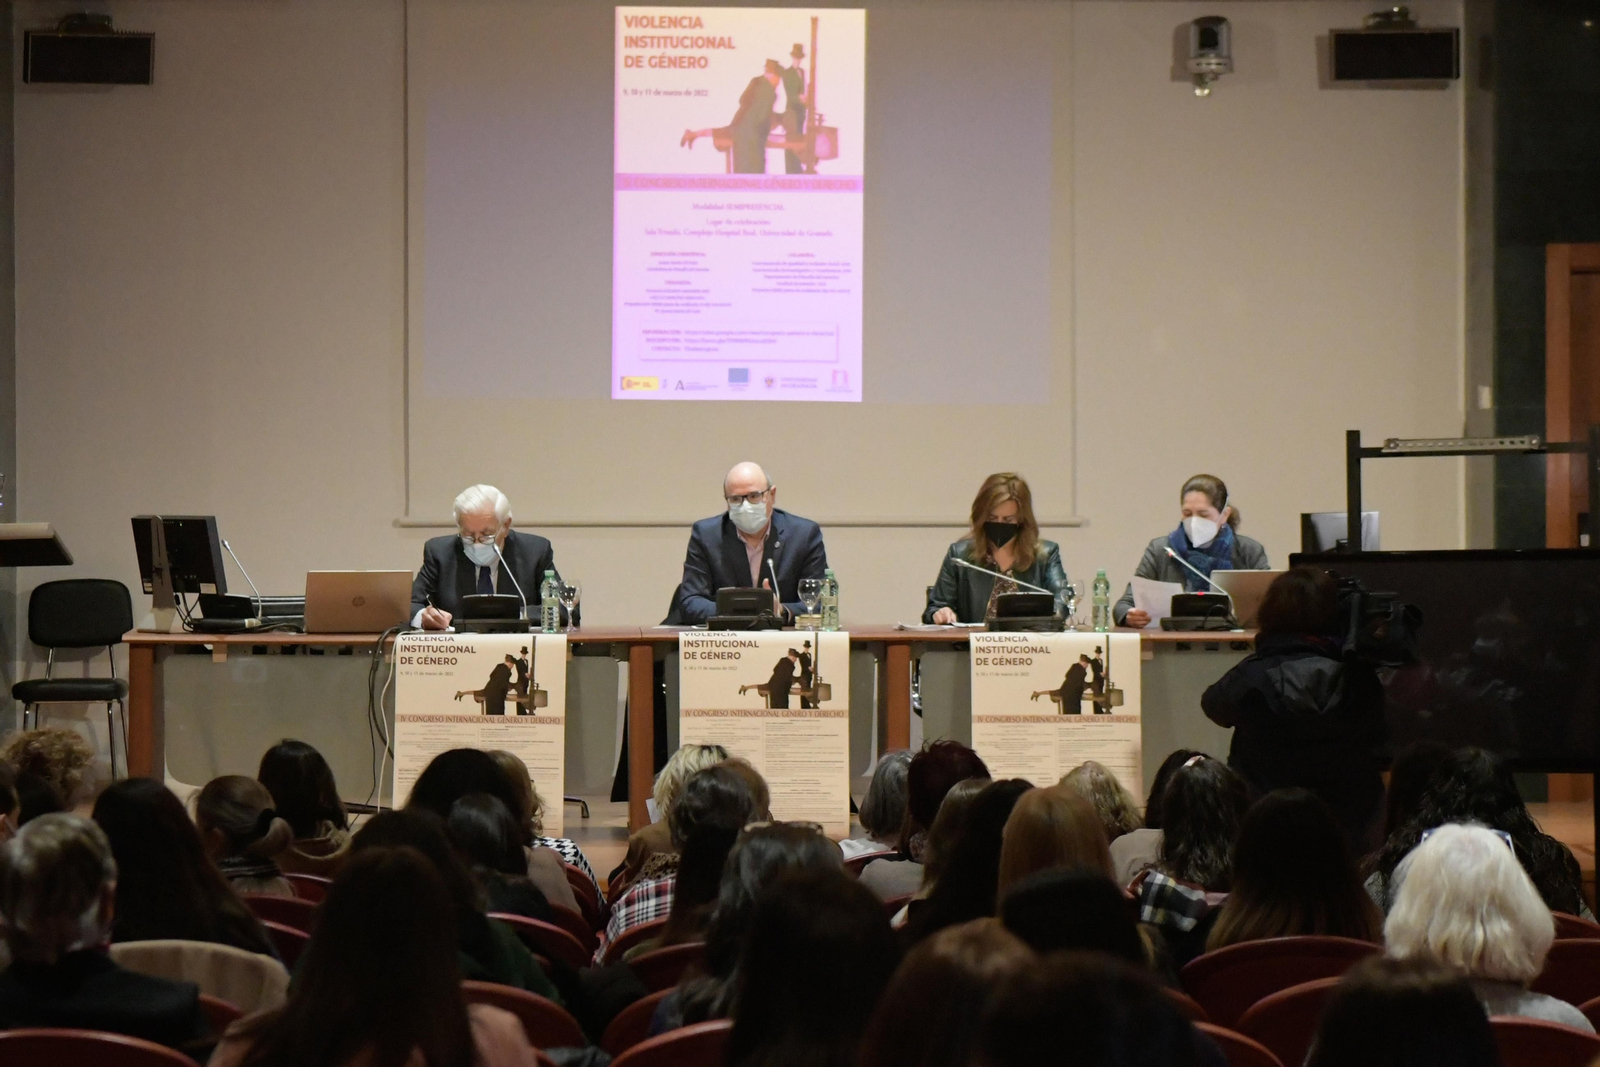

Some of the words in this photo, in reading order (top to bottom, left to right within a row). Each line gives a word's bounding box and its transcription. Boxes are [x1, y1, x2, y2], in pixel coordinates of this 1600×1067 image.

[624, 15, 704, 29] VIOLENCIA
[624, 35, 736, 50] INSTITUCIONAL
[623, 55, 644, 68] DE
[648, 52, 709, 69] GÉNERO
[653, 88, 661, 97] de
[662, 88, 683, 97] marzo
[684, 88, 692, 97] de
[693, 88, 709, 97] 2022
[683, 640, 759, 648] INSTITUCIONAL
[400, 645, 476, 654] INSTITUCIONAL
[975, 646, 1051, 654] INSTITUCIONAL
[684, 652, 697, 660] DE
[700, 650, 741, 660] GÉNERO
[400, 656, 414, 665] DE
[416, 655, 458, 666] GÉNERO
[975, 657, 989, 666] DE
[992, 656, 1033, 666] GÉNERO
[730, 710, 779, 718] INTERNACIONAL
[814, 710, 844, 718] DERECHO
[985, 715, 1021, 723] CONGRESO
[1022, 715, 1072, 723] INTERNACIONAL
[1074, 714, 1100, 723] GÉNERO
[1107, 715, 1137, 724] DERECHO
[408, 715, 444, 723] CONGRESO
[445, 715, 496, 724] INTERNACIONAL
[498, 714, 524, 724] GÉNERO
[531, 716, 561, 725] DERECHO
